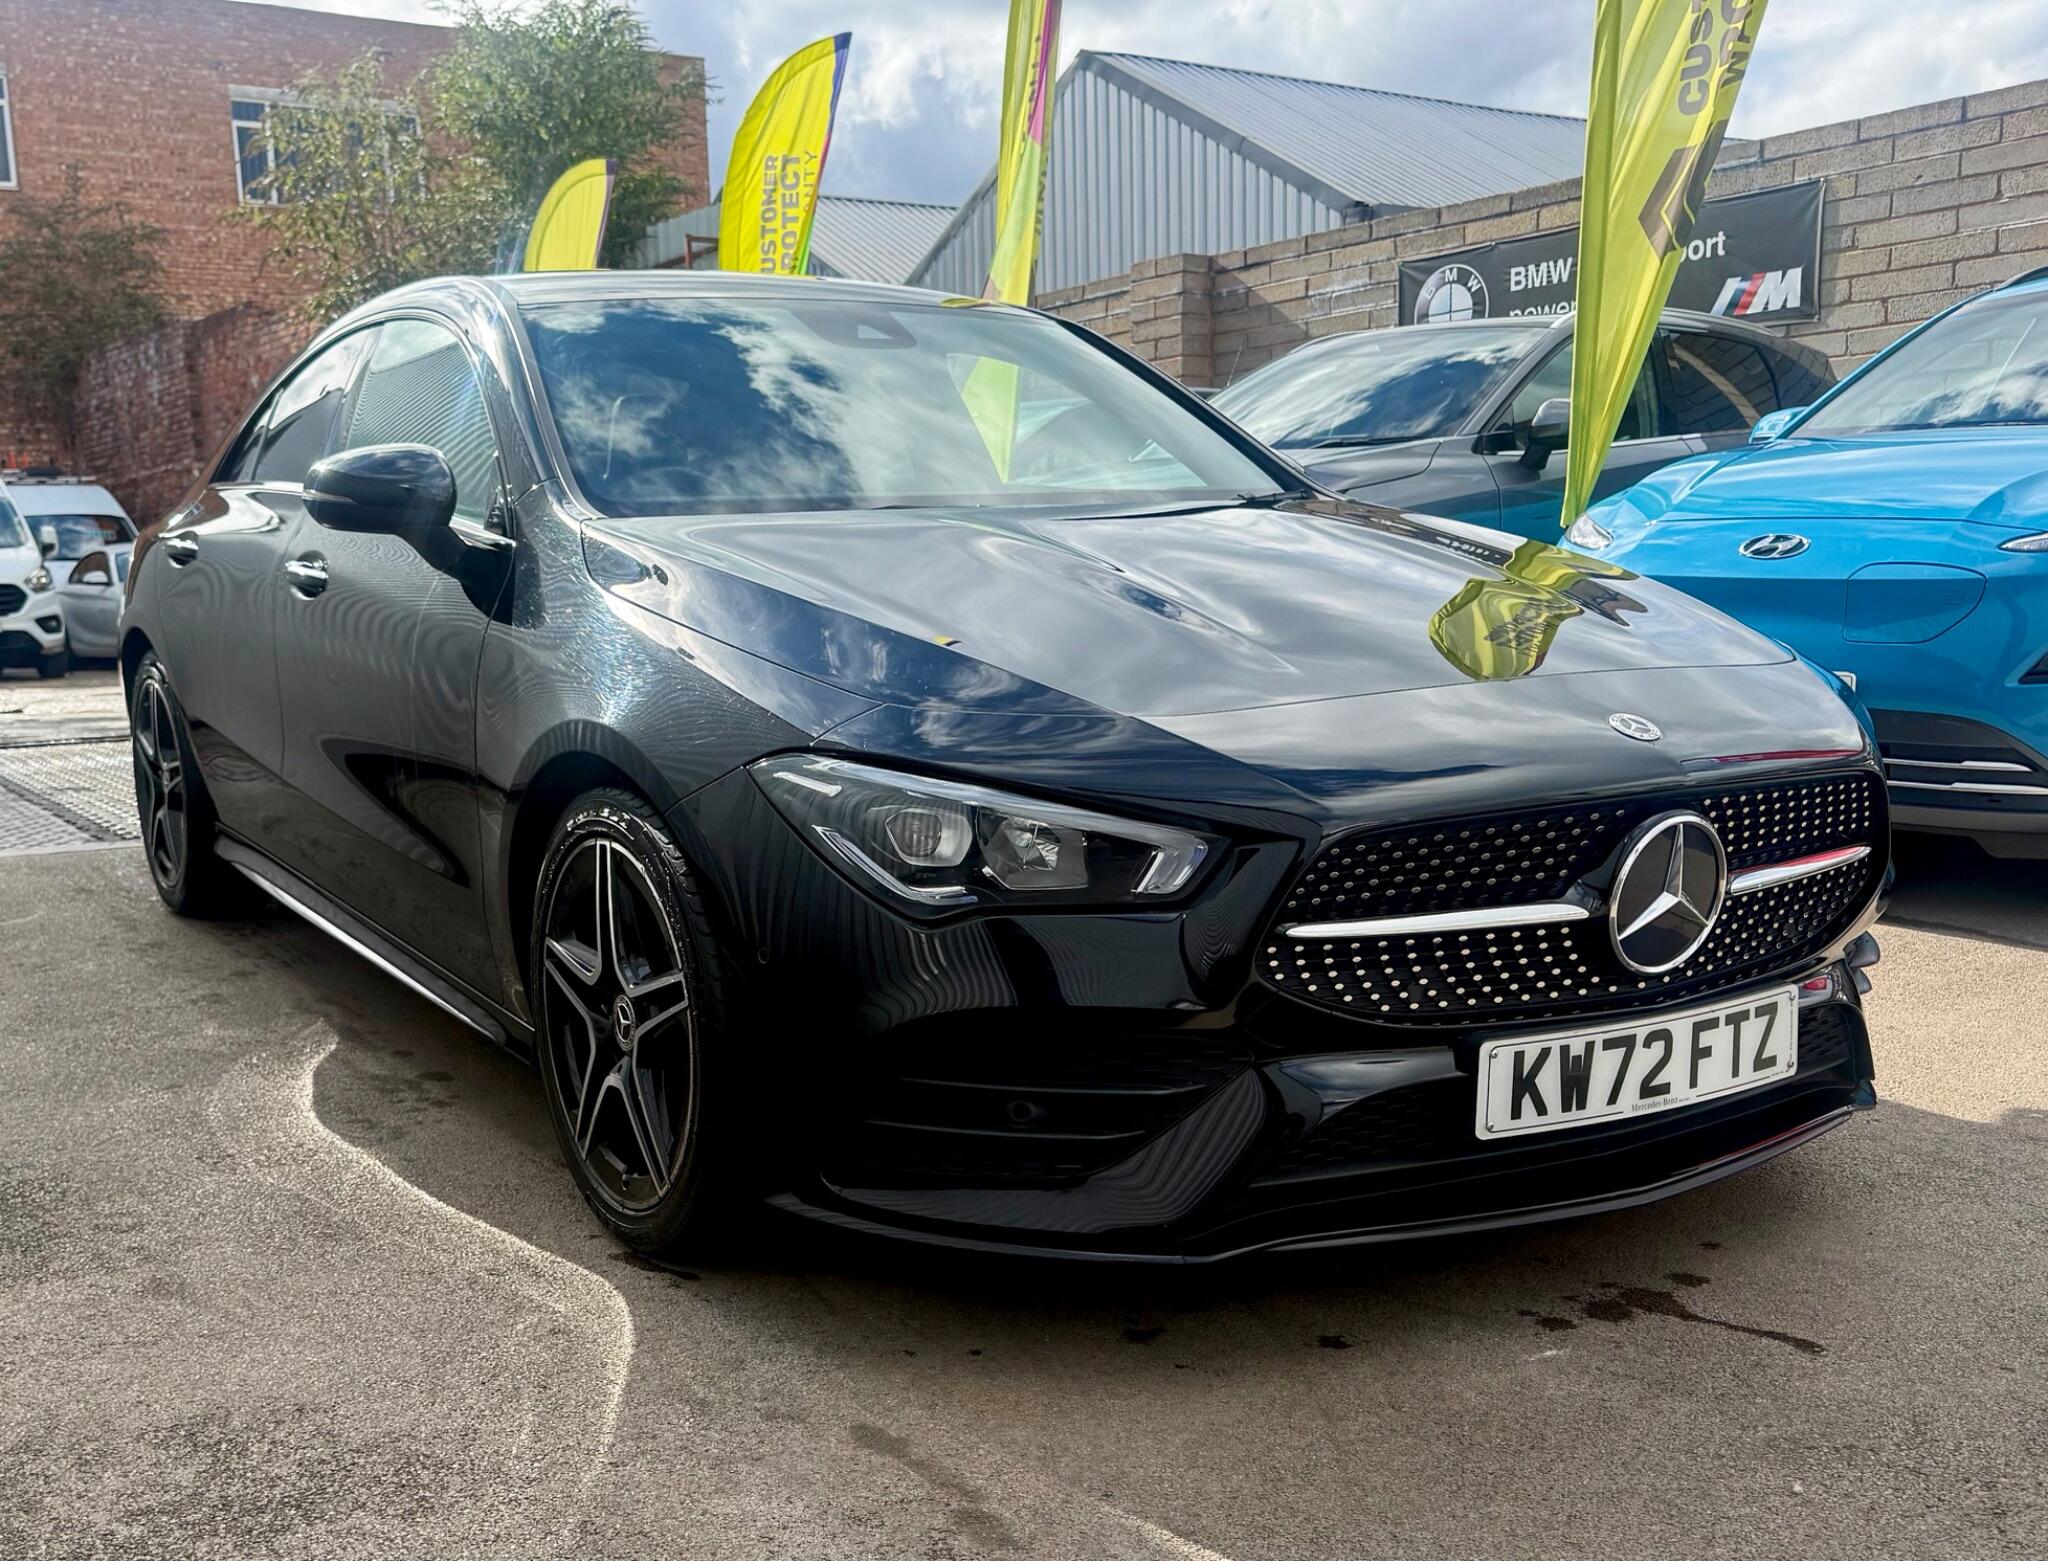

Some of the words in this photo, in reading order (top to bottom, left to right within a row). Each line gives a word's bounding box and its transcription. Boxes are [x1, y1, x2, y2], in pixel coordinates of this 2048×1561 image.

[761, 155, 777, 273] USTOMER
[781, 153, 800, 271] ROTECT
[1510, 256, 1573, 292] BMW
[1680, 230, 1726, 263] ort
[1424, 267, 1482, 300] BMW
[1510, 1028, 1674, 1121] KW72
[1689, 1001, 1779, 1090] FTZ
